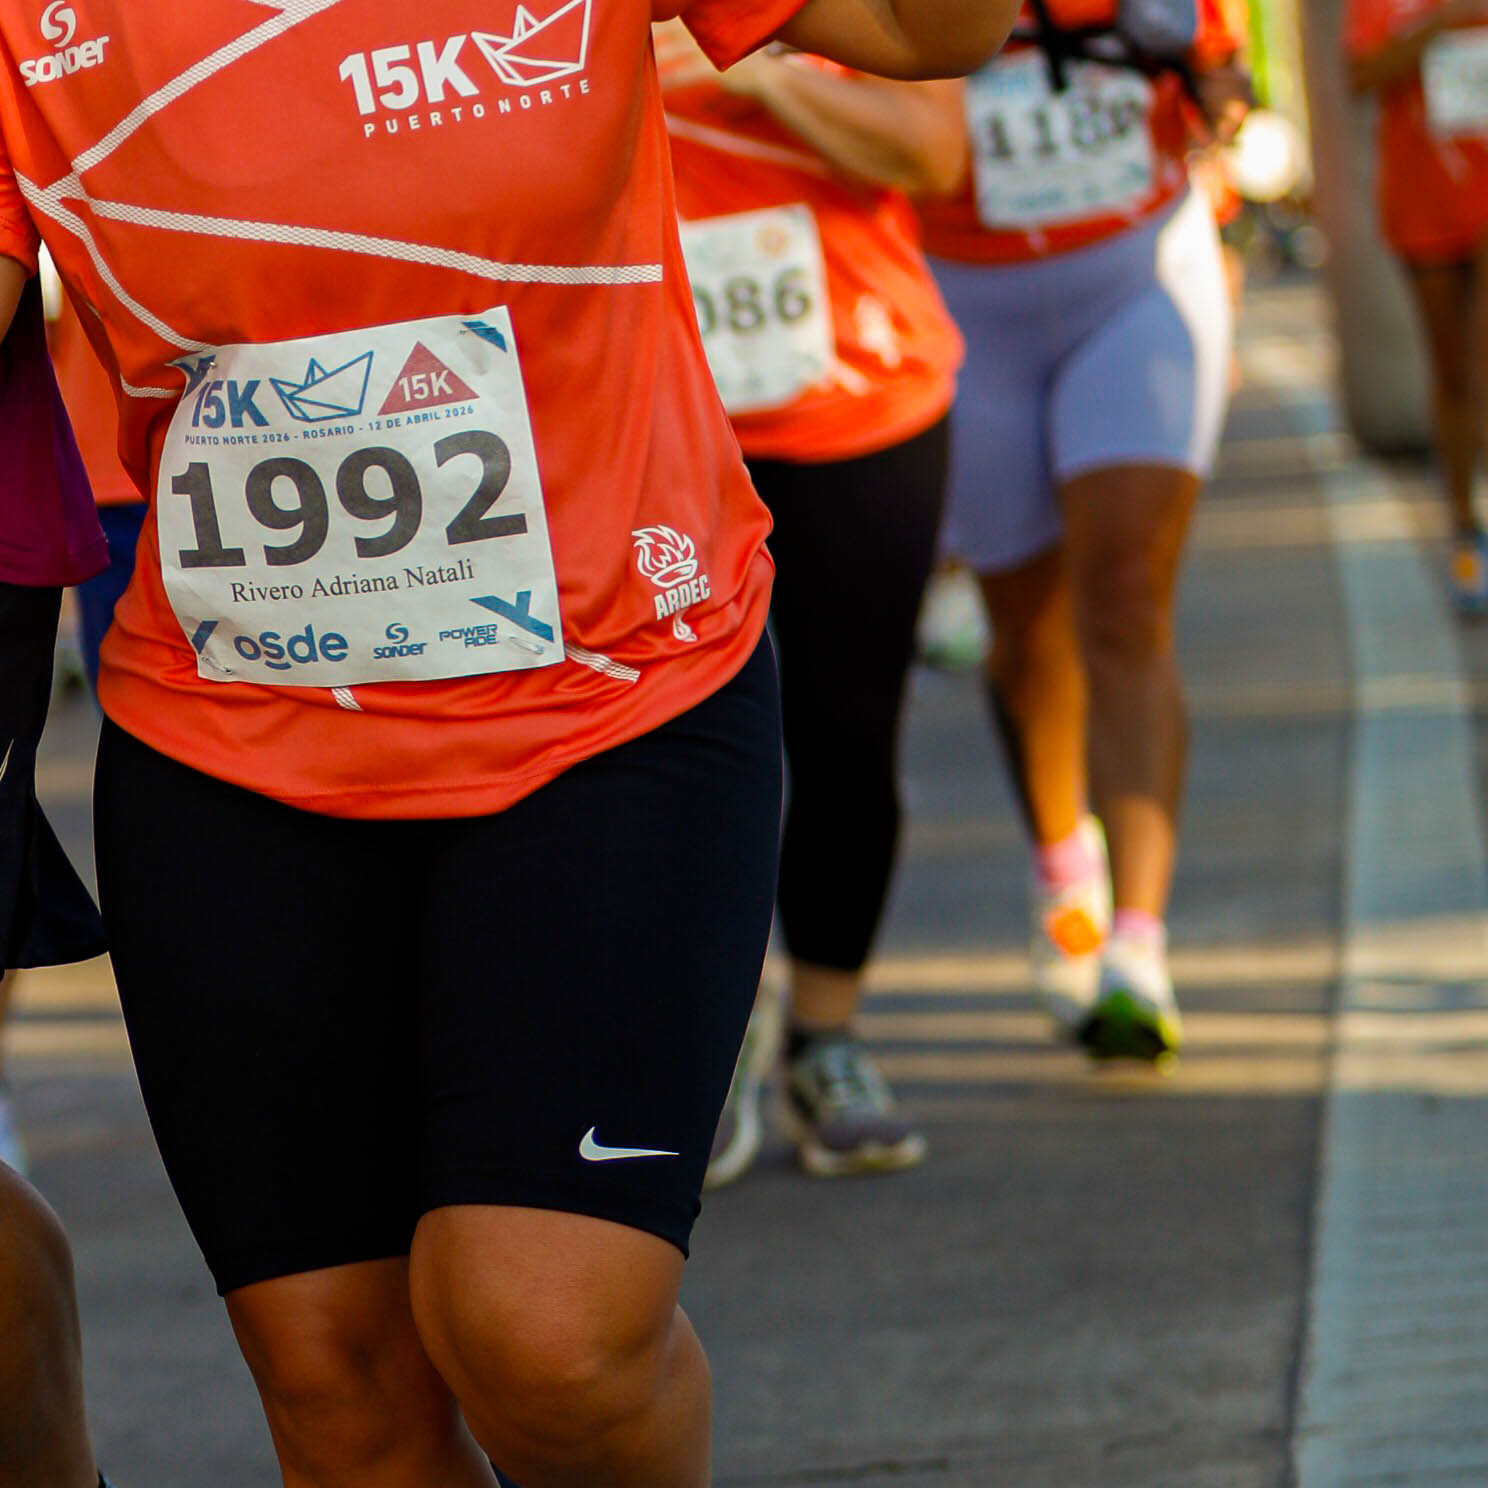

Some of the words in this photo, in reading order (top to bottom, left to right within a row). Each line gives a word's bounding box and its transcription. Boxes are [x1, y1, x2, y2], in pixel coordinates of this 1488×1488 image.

[338, 33, 480, 116] 15K
[364, 104, 485, 138] PUERTO
[498, 79, 590, 114] NORTE
[192, 380, 270, 428] 15K
[398, 369, 453, 402] 15K
[185, 434, 219, 445] PUERTO
[223, 435, 258, 445] NORTE
[262, 432, 290, 443] 2026
[303, 425, 354, 440] ROSARIO
[369, 421, 381, 430] 12
[386, 418, 401, 428] DE
[406, 412, 441, 426] ABRIL
[445, 405, 474, 418] 2026
[171, 430, 528, 569] 1992
[230, 582, 303, 603] Rivero
[311, 573, 399, 598] Adriana
[402, 559, 475, 588] Natali
[654, 574, 711, 620] ARDEC
[233, 623, 349, 665] osde
[439, 624, 498, 642] POWER
[464, 634, 499, 648] ADE
